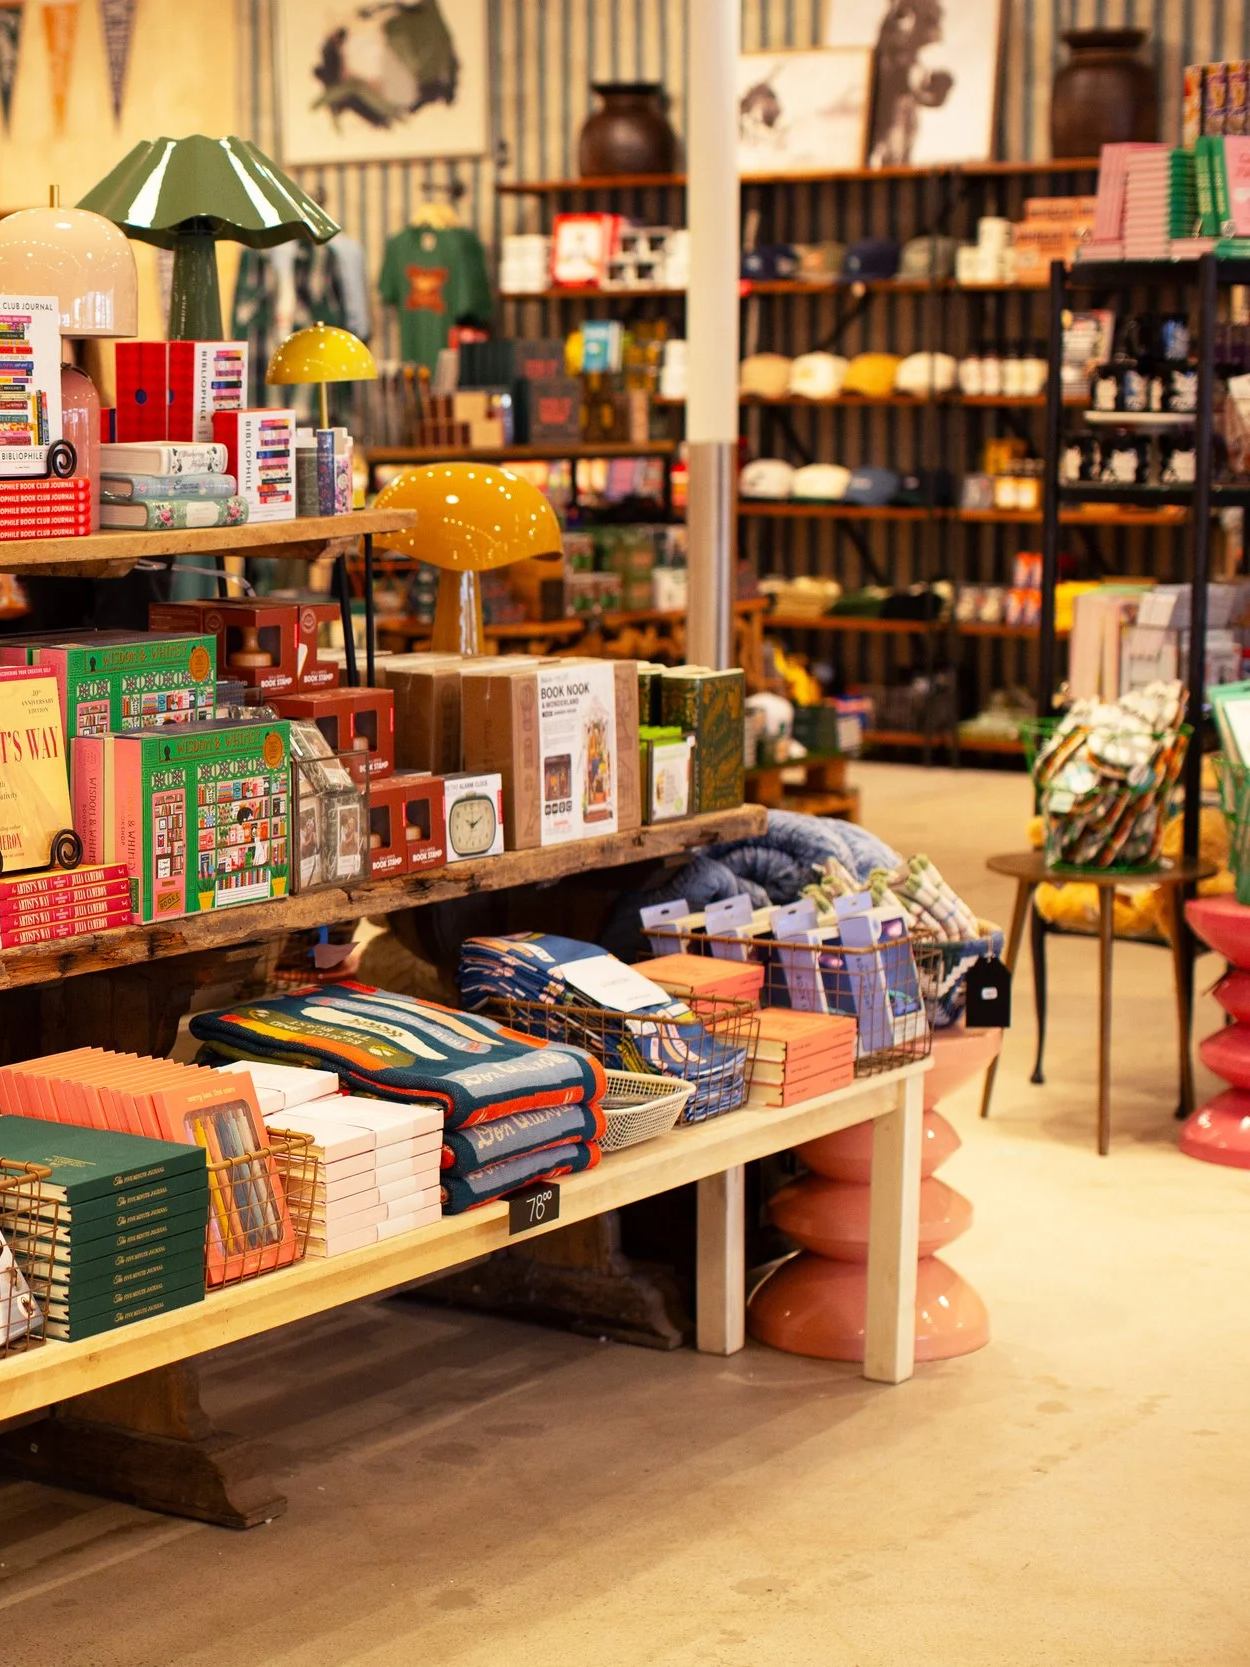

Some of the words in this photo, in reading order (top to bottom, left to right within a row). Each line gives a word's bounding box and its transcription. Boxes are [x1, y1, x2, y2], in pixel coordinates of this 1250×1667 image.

[2, 302, 20, 310] CLUB
[21, 303, 53, 311] JOURNAL
[2, 452, 43, 460] BIBLIOPHILE
[102, 650, 138, 666] WISDOM
[140, 648, 147, 662] &
[151, 644, 187, 659] WHIMSY
[261, 679, 277, 688] BOOK
[277, 677, 292, 685] STAMP
[303, 675, 318, 683] BOOK
[318, 673, 334, 681] STAMP
[541, 685, 564, 699] BOOK
[566, 682, 590, 696] NOOK
[21, 698, 54, 707] ANNIVERSARY
[546, 698, 579, 708] WONDERLAND
[26, 726, 58, 760] WAY
[177, 739, 210, 754] WISDOM
[214, 736, 221, 750] &
[224, 731, 261, 747] WHIMSY
[373, 761, 389, 770] STAMP
[89, 777, 97, 817] WISDOM
[89, 819, 97, 828] &
[413, 853, 427, 862] BOOK
[428, 850, 442, 859] STAMP
[373, 861, 387, 870] BOOK
[388, 857, 402, 866] STAMP
[17, 880, 38, 895] ARTIST'S
[38, 880, 48, 891] WAY
[71, 873, 84, 886] JULIA
[84, 870, 104, 884] CAMERON
[18, 897, 39, 911] ARTIST'S
[39, 895, 49, 907] WAY
[73, 889, 86, 902] JULIA
[86, 885, 107, 899] CAMERON
[159, 893, 180, 909] BOOKS
[19, 912, 40, 927] ARTIST'S
[40, 911, 50, 923] WAY
[74, 904, 87, 918] JULIA
[87, 901, 108, 914] CAMERON
[19, 929, 40, 943] ARTIST'S
[40, 928, 50, 939] WAY
[74, 921, 87, 934] JULIA
[87, 917, 107, 931] CAMERON
[472, 1120, 515, 1149] Don
[147, 1166, 165, 1176] JOURNAL
[150, 1187, 168, 1196] JOURNAL
[150, 1207, 168, 1216] JOURNAL
[150, 1226, 167, 1236] JOURNAL
